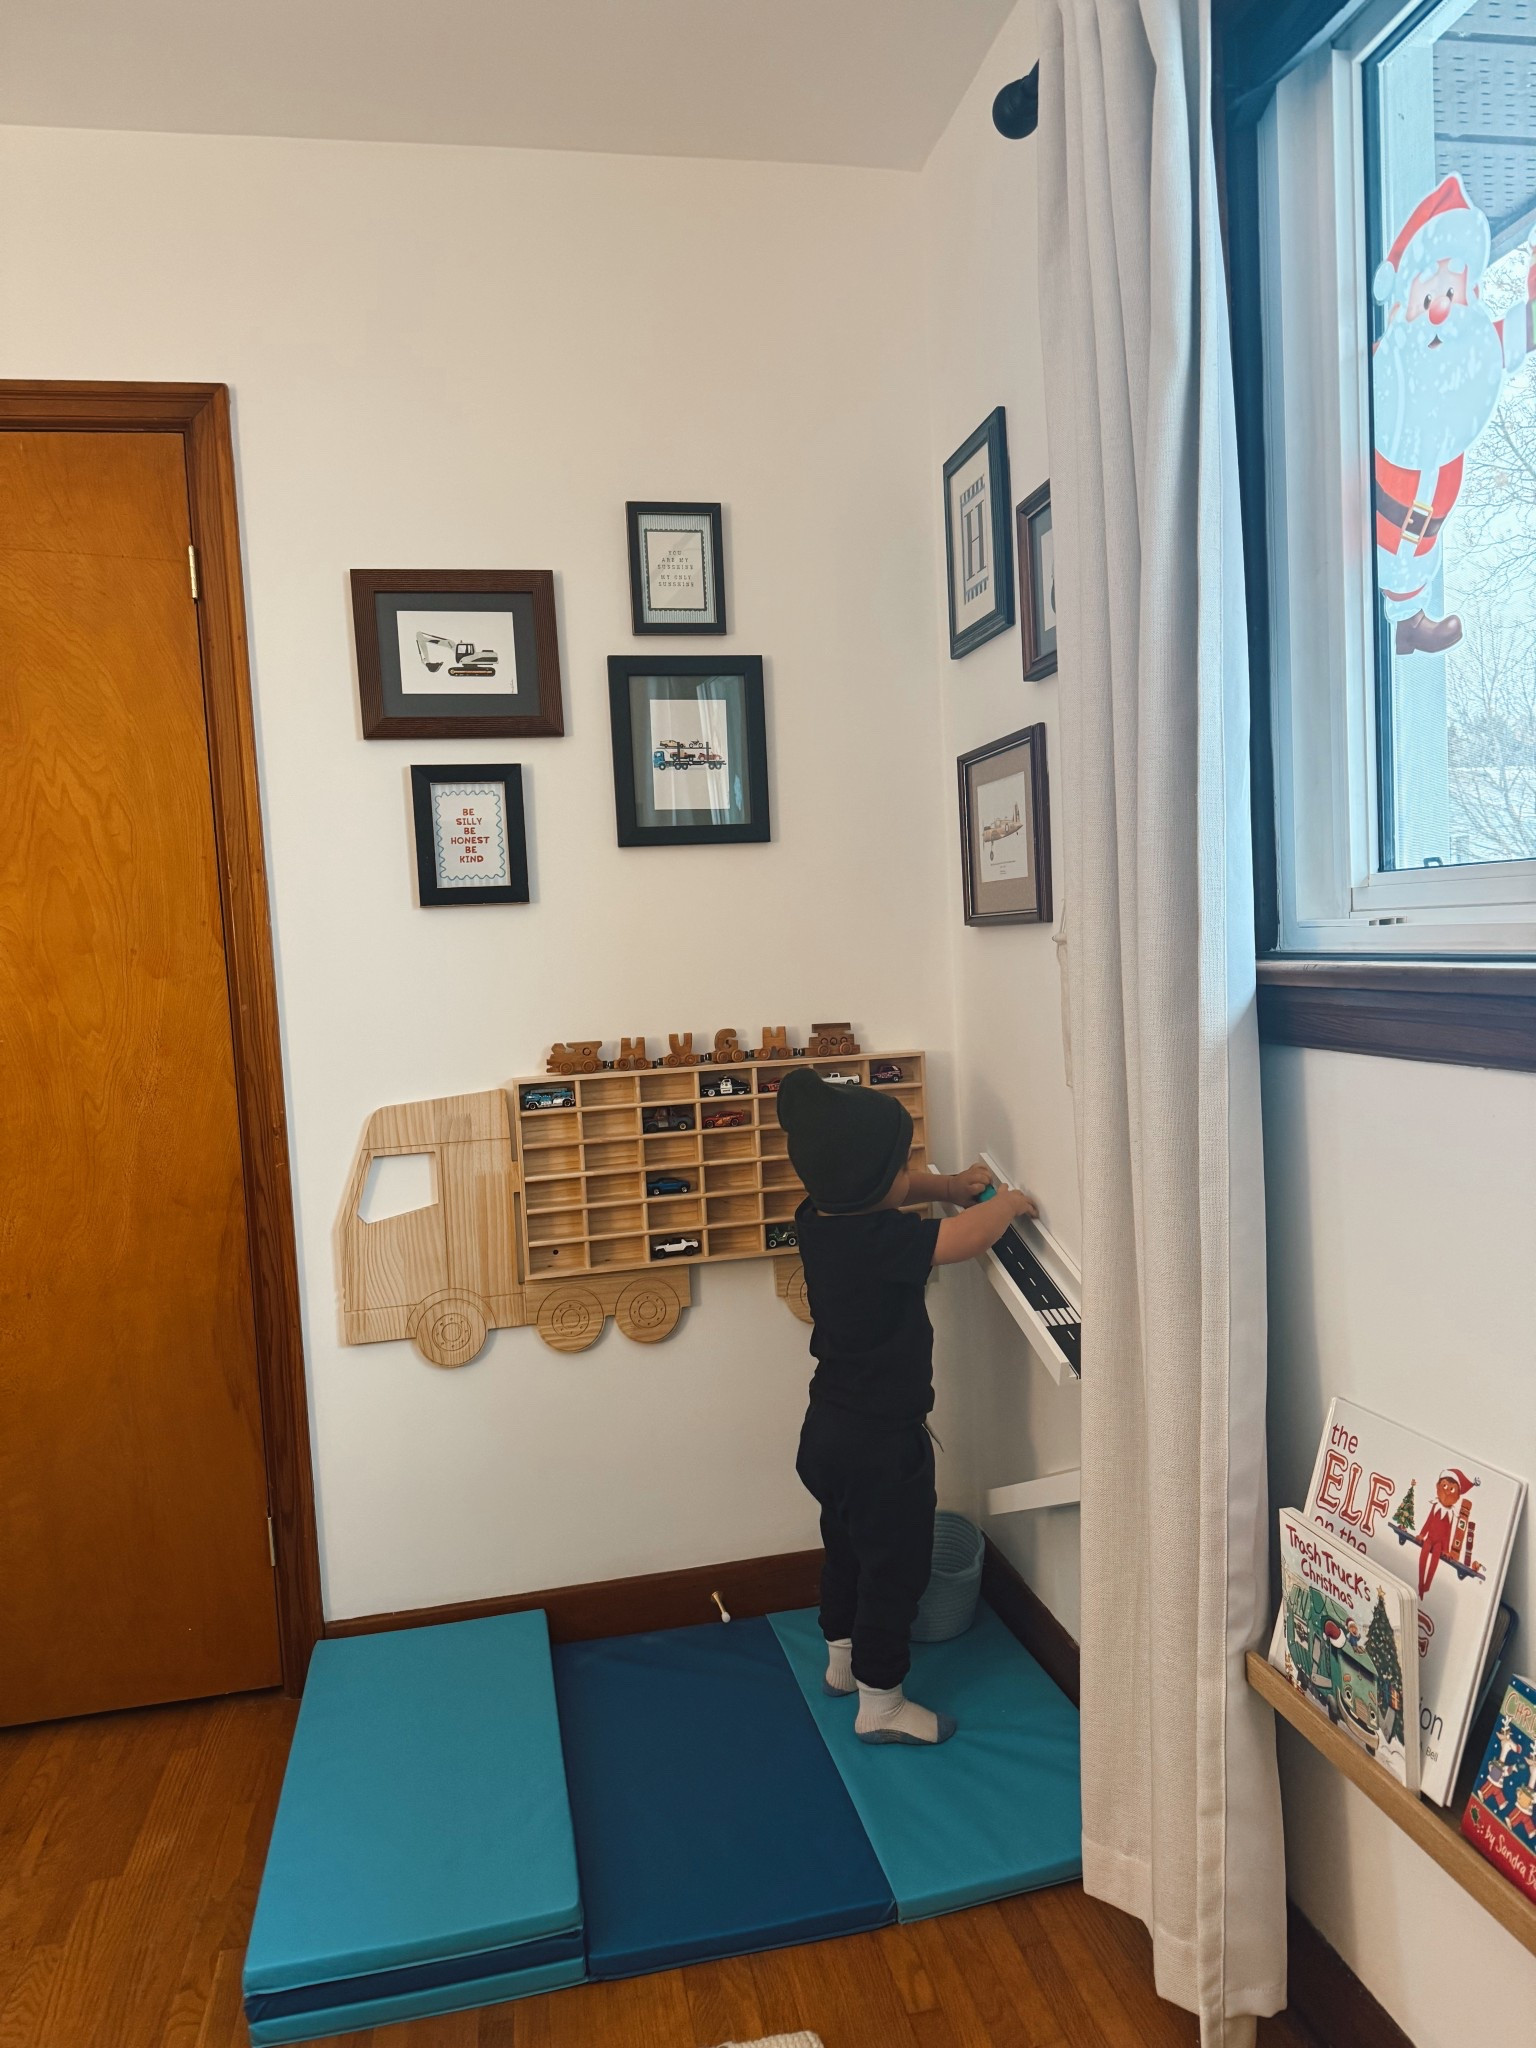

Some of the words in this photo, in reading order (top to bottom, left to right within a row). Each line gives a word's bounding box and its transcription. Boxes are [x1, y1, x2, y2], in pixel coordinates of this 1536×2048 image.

[462, 808, 475, 816] BE
[455, 818, 482, 826] SILLY
[463, 827, 476, 835] BE
[450, 836, 490, 845] HONEST
[465, 846, 478, 854] BE
[459, 855, 484, 864] KIND
[1331, 1422, 1358, 1454] the
[1316, 1449, 1396, 1538] ELF
[1285, 1524, 1321, 1568] Trash
[1321, 1551, 1371, 1602] Truck's
[1300, 1558, 1354, 1610] Christmas
[1484, 1825, 1496, 1851] by
[1495, 1834, 1526, 1878] Sandra
